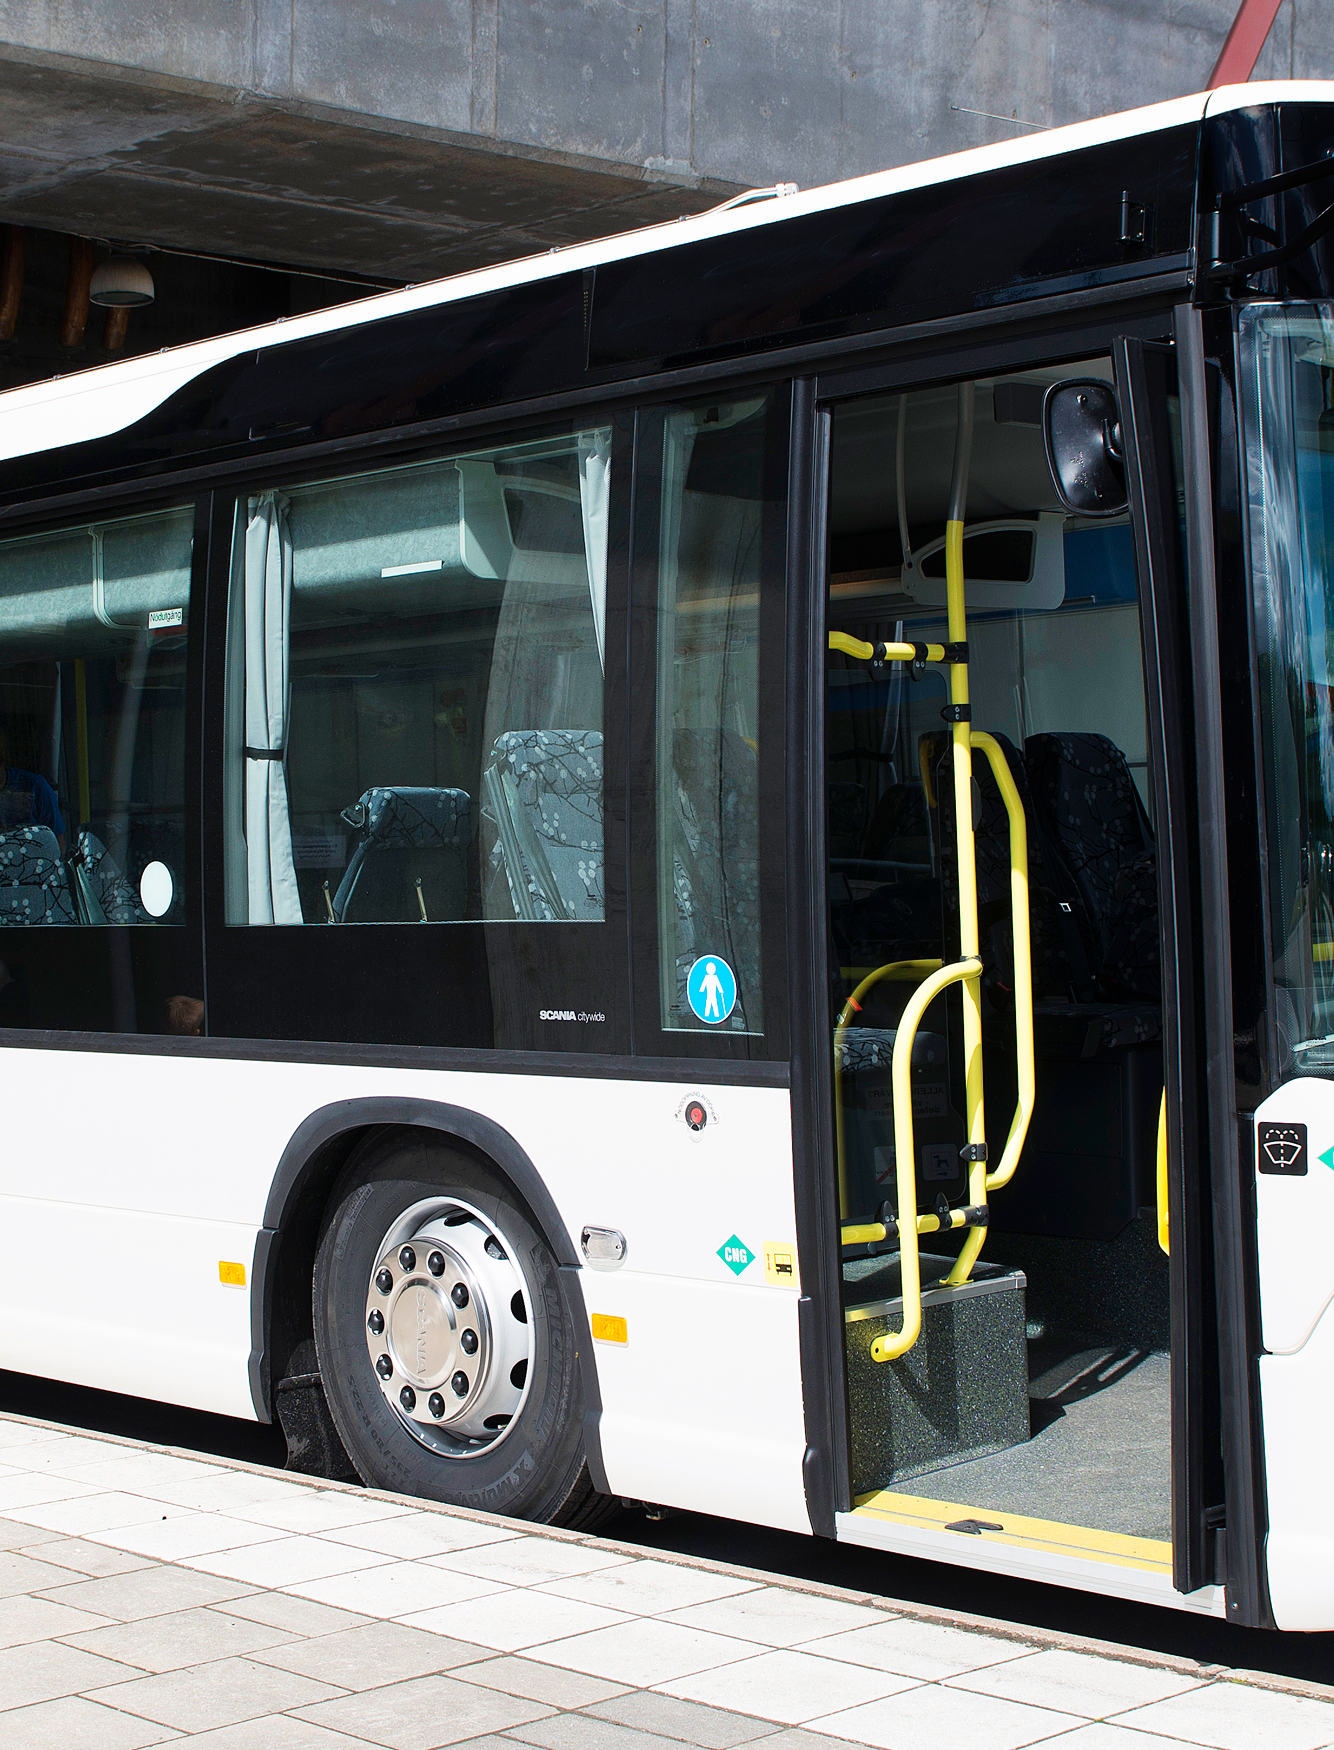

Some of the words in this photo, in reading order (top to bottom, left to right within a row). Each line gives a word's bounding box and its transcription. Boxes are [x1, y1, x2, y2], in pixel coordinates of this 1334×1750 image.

[150, 610, 181, 622] Nödutgång
[539, 1010, 576, 1021] SCANIA
[577, 1011, 605, 1023] citywide
[724, 1246, 748, 1264] CNG
[417, 1288, 427, 1375] SCANIA
